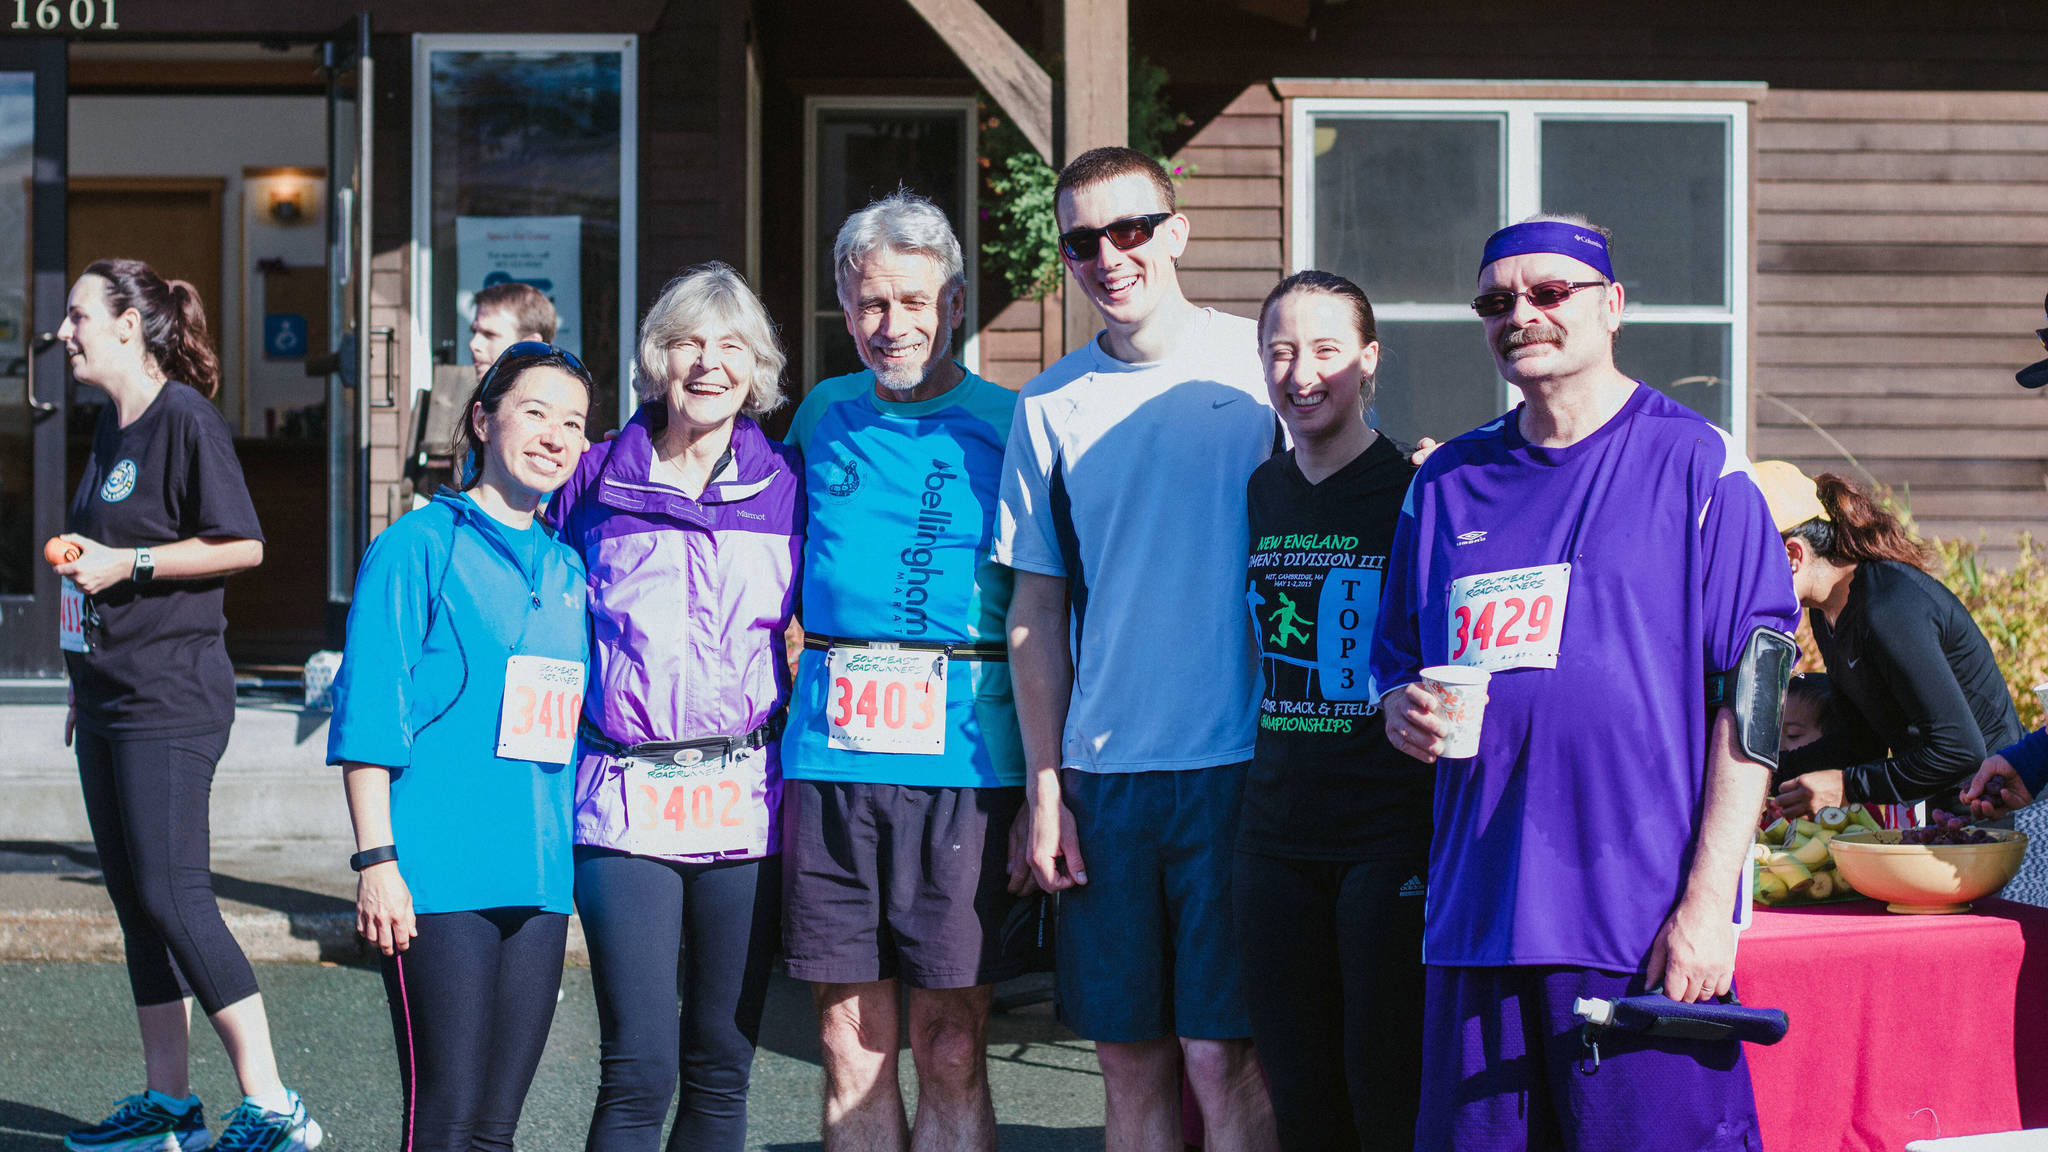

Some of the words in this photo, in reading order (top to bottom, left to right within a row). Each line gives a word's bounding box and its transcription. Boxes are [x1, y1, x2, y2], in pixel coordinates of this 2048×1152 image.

[11, 0, 120, 30] 1601
[736, 510, 765, 520] Marmot
[1257, 535, 1282, 551] NEW
[1284, 533, 1359, 551] ENGLAND
[901, 471, 957, 636] bellingham
[1284, 552, 1356, 568] DIVISION
[1358, 555, 1386, 569] III
[1465, 579, 1545, 600] ROADRUNNERS
[1473, 571, 1543, 589] SOUTHEAST
[1339, 580, 1361, 658] TOP
[1453, 595, 1554, 660] 3429
[846, 663, 924, 675] ROADRUNNERS
[852, 654, 920, 666] SOUTHEAST
[1340, 668, 1354, 689] 3
[512, 685, 582, 741] 3410
[834, 676, 936, 730] 3403
[1280, 700, 1316, 714] TRACK
[1318, 702, 1331, 716] &
[1334, 703, 1378, 716] FIELD
[639, 780, 745, 832] 3402
